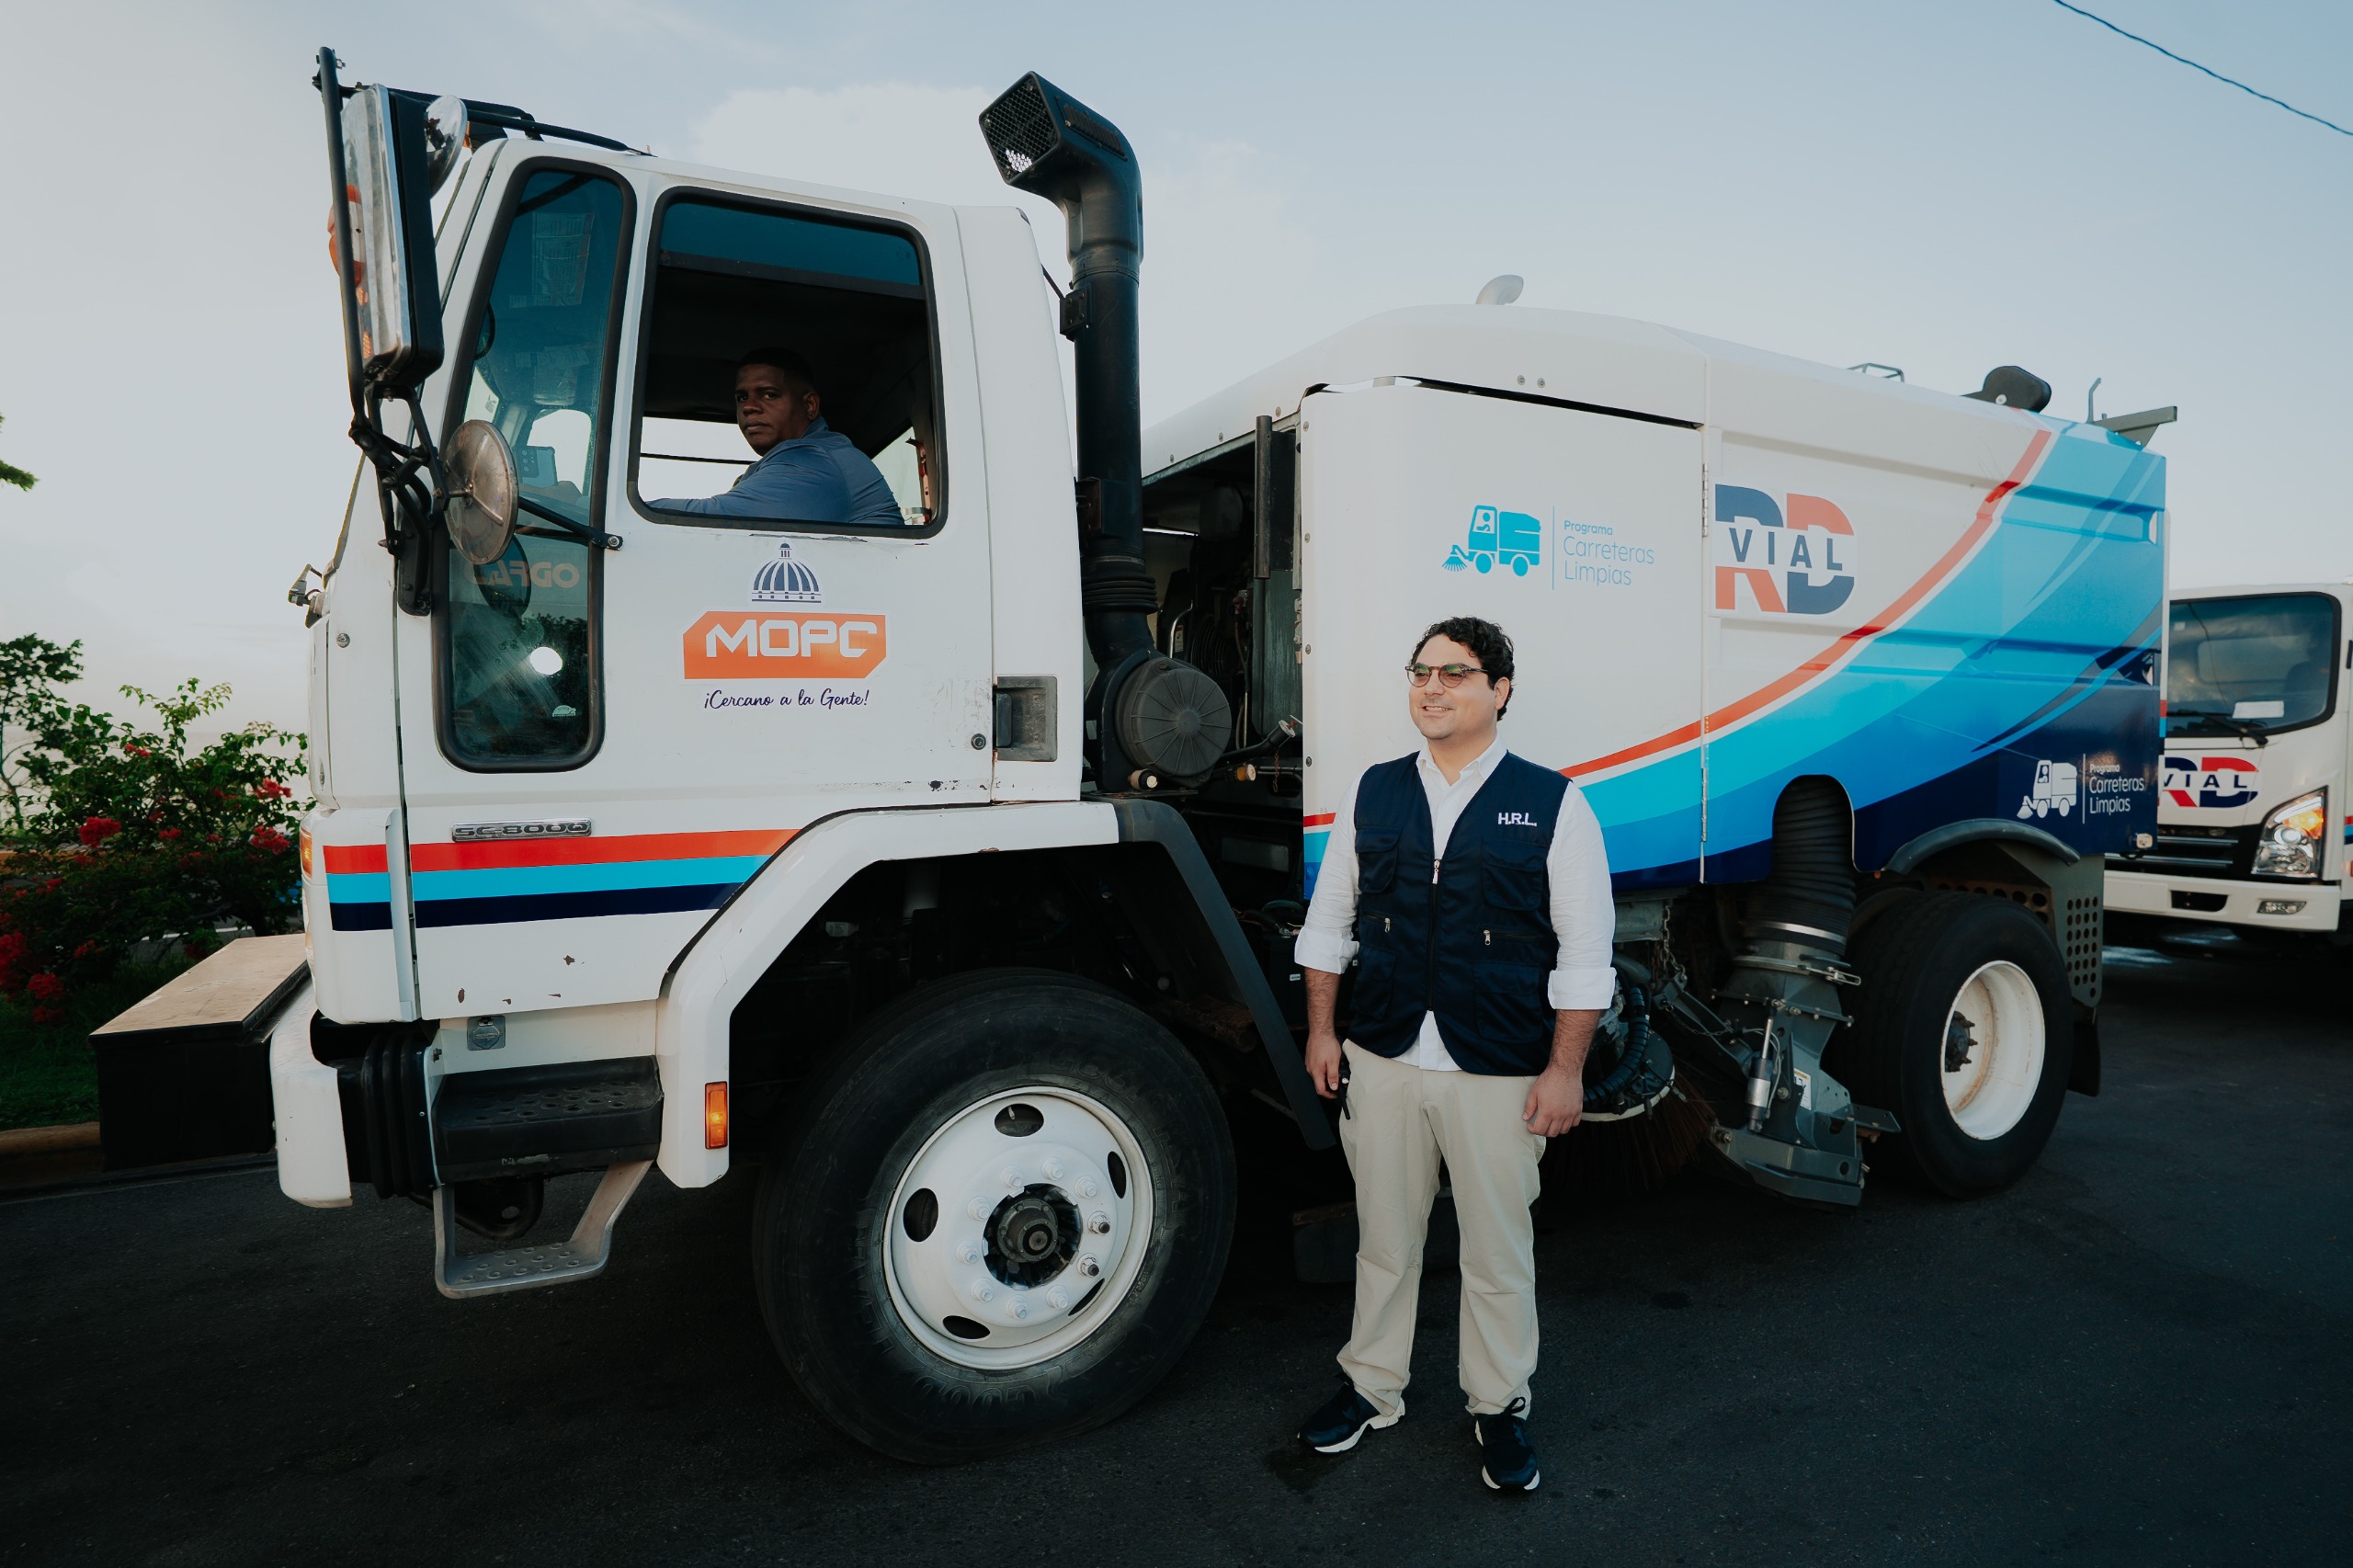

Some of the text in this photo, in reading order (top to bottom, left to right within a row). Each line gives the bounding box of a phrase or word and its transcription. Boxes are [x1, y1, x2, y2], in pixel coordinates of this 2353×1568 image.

[1564, 520, 1613, 535] Programa
[1563, 536, 1654, 564] Carreteras
[1728, 527, 1843, 571] VIAL
[1564, 560, 1631, 586] Limpias
[705, 619, 878, 658] MOPC
[704, 687, 870, 710] ¡Cercano a la Gente!
[2089, 764, 2120, 775] Programa
[2089, 776, 2145, 794] Carreteras
[2089, 796, 2131, 816] Limpias
[1497, 812, 1538, 827] H.R.L.
